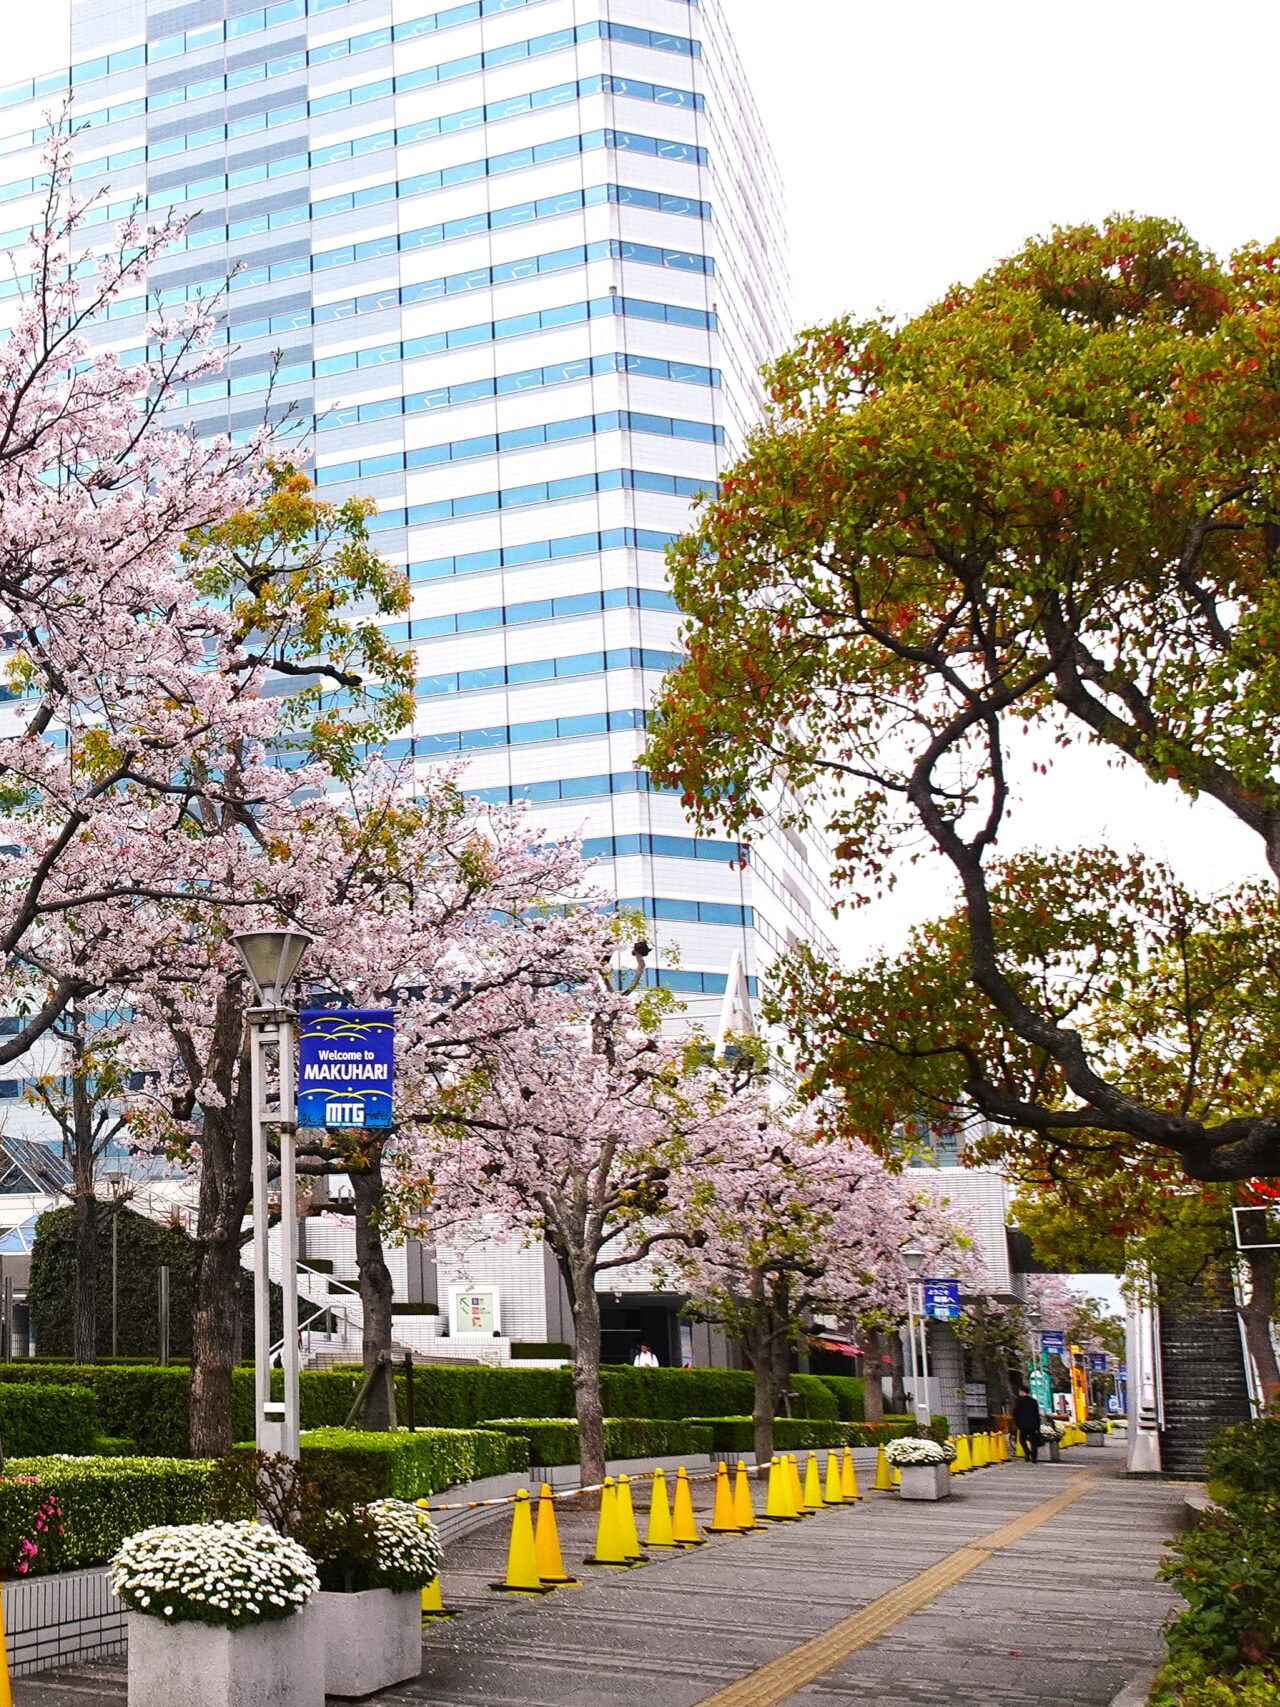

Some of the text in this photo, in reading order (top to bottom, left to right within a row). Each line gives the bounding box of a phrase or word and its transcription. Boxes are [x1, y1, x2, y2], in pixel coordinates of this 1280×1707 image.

[318, 1050, 374, 1061] Welcome to
[304, 1064, 388, 1080] MAKUHARI
[325, 1103, 365, 1122] MTG
